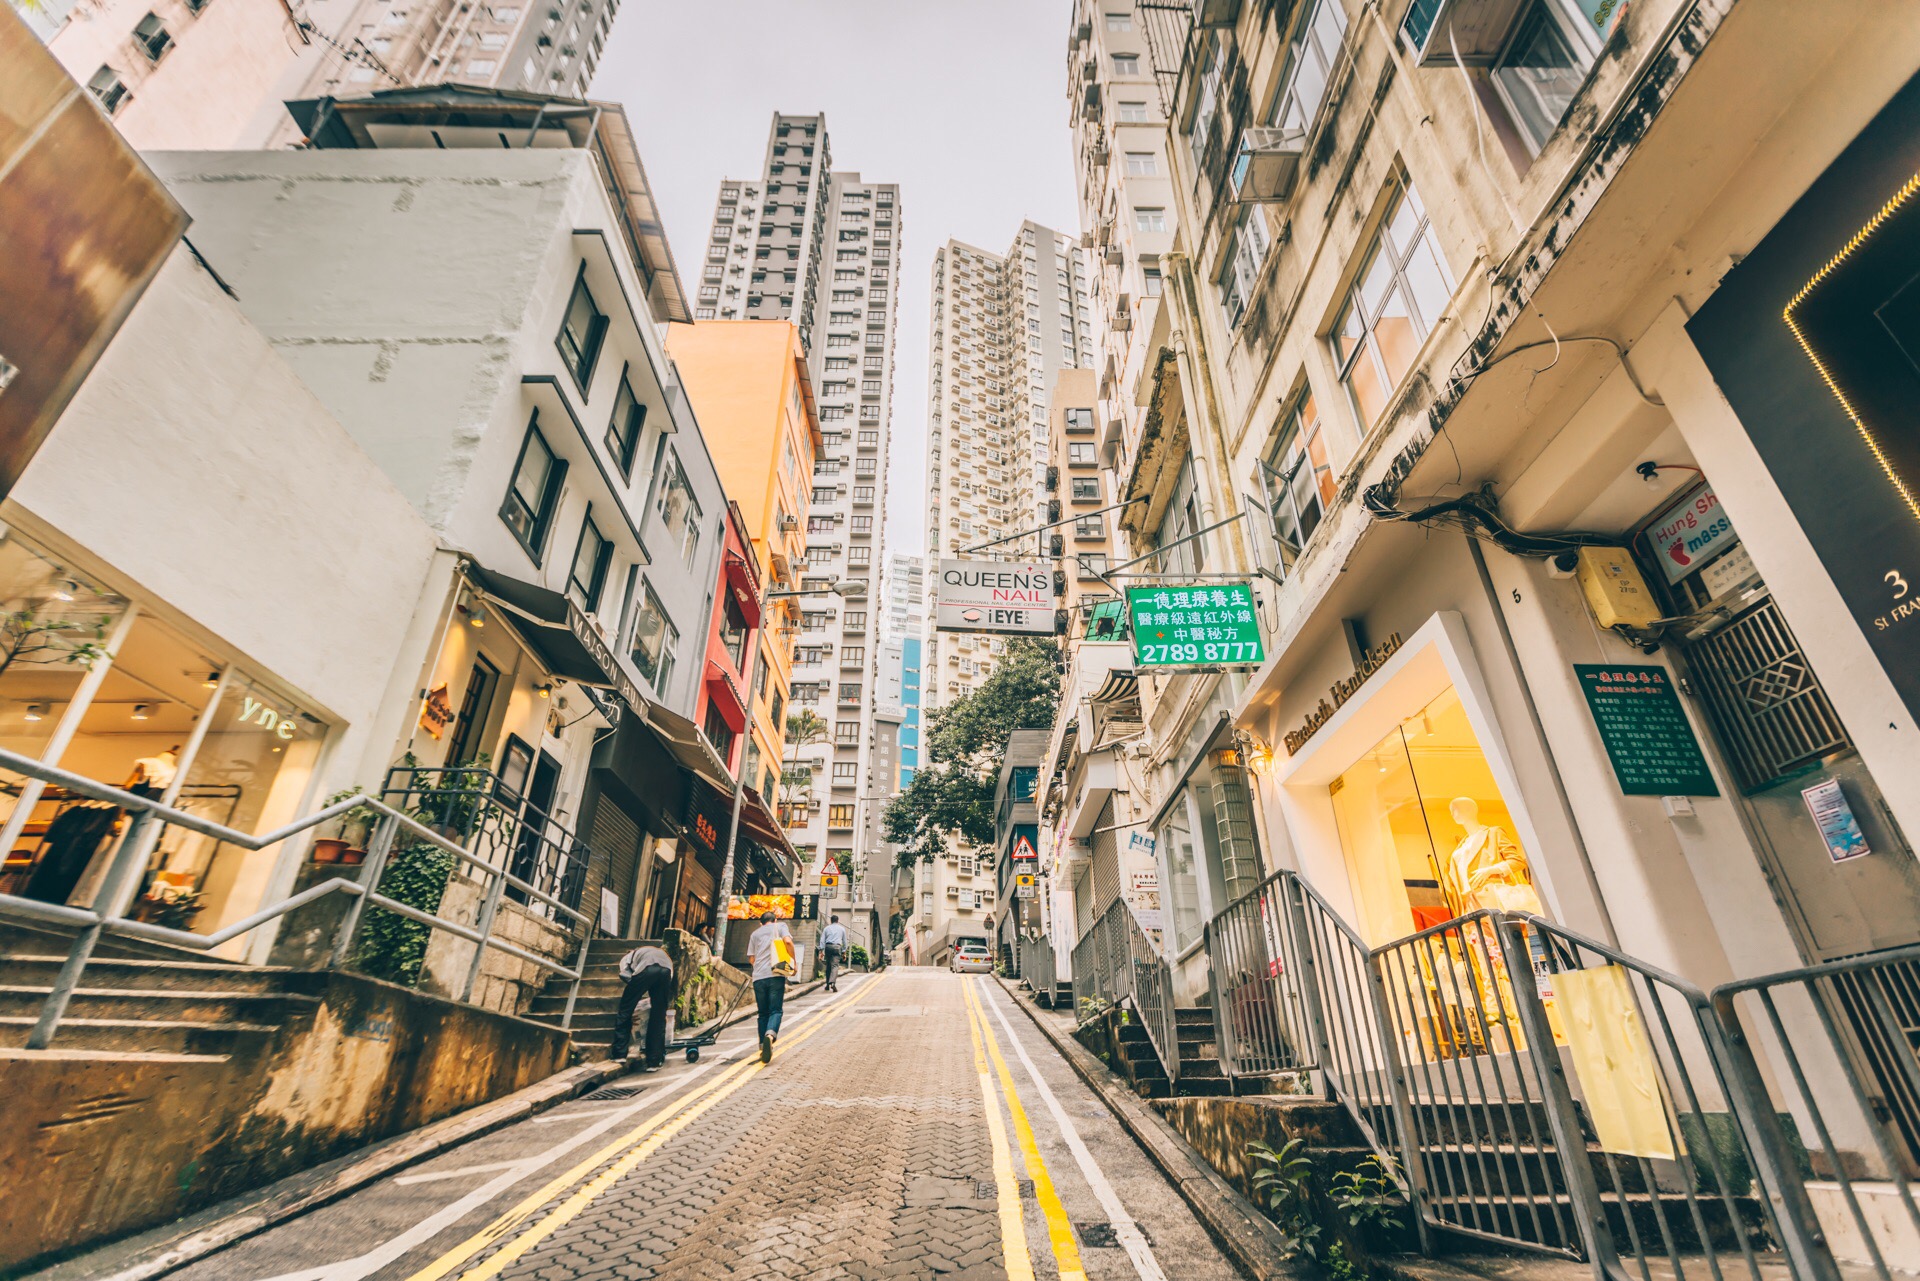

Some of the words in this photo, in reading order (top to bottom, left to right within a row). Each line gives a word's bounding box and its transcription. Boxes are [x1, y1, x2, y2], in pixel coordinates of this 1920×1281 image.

[1656, 510, 1698, 544] Hung
[1688, 517, 1732, 553] mass
[1884, 568, 1909, 600] 3
[993, 589, 1047, 602] NAIL
[1135, 589, 1249, 610] 一德理療養生
[1512, 587, 1522, 604] 5
[1137, 609, 1253, 626] 醫療級遠紅外線
[1874, 616, 1890, 631] St
[1173, 626, 1239, 642] 中醫秘方
[1142, 643, 1199, 663] 2789
[1204, 641, 1258, 662] 8777
[574, 614, 618, 681] MAISON
[622, 681, 645, 715] HUIT
[1283, 698, 1335, 757] Elizabeth
[1329, 631, 1404, 710] Henricksen
[238, 696, 297, 740] yne
